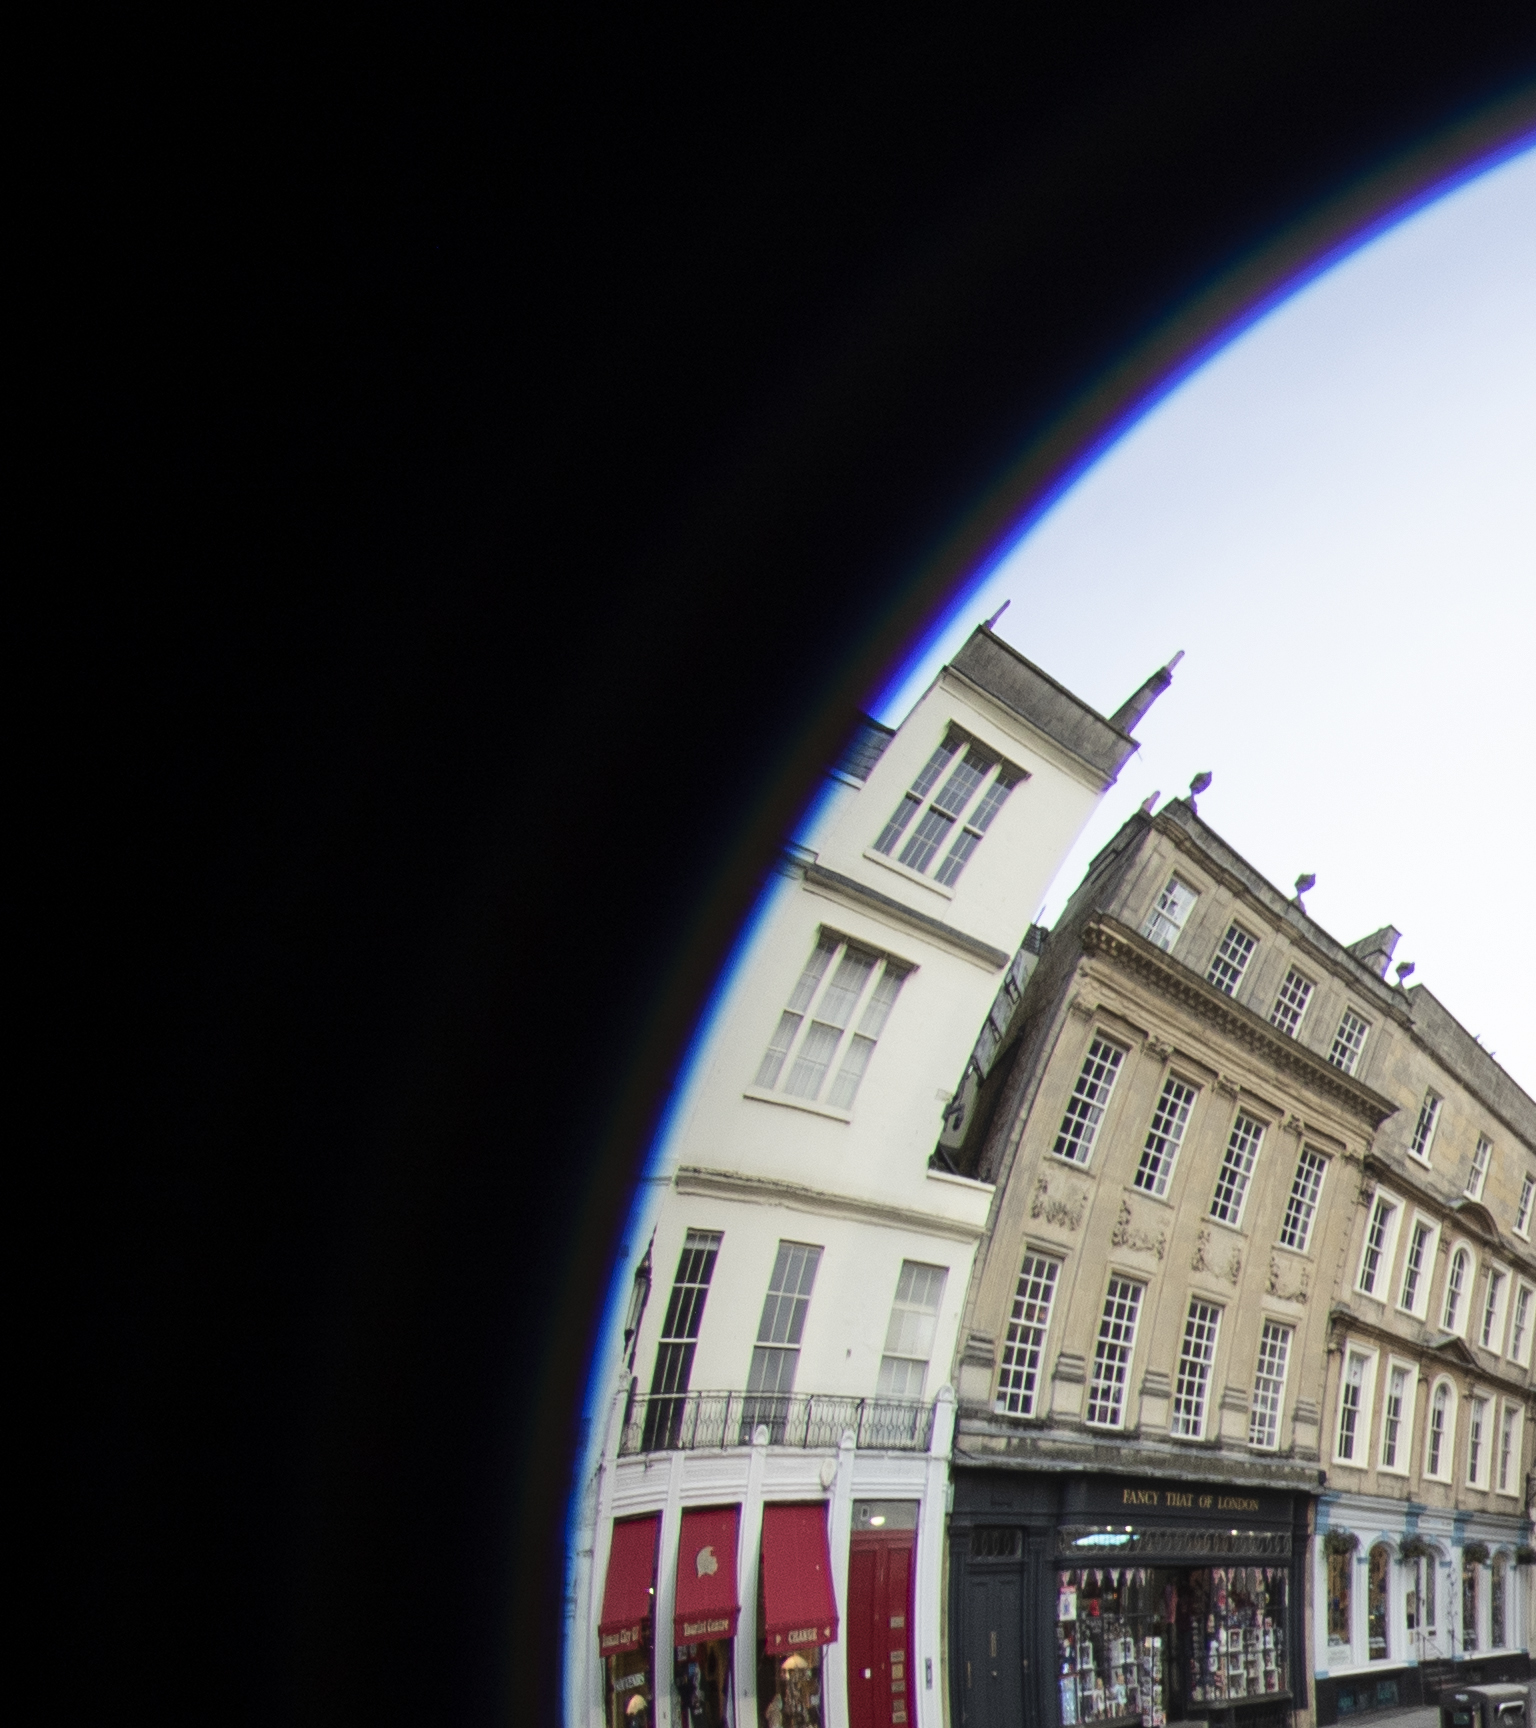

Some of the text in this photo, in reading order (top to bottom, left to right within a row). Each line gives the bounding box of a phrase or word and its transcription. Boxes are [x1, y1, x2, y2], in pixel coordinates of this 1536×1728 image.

[1122, 1488, 1259, 1511] FANCY THAT OF LONDON
[683, 1619, 729, 1637] Tourist Centre
[788, 1628, 817, 1644] CHANGE
